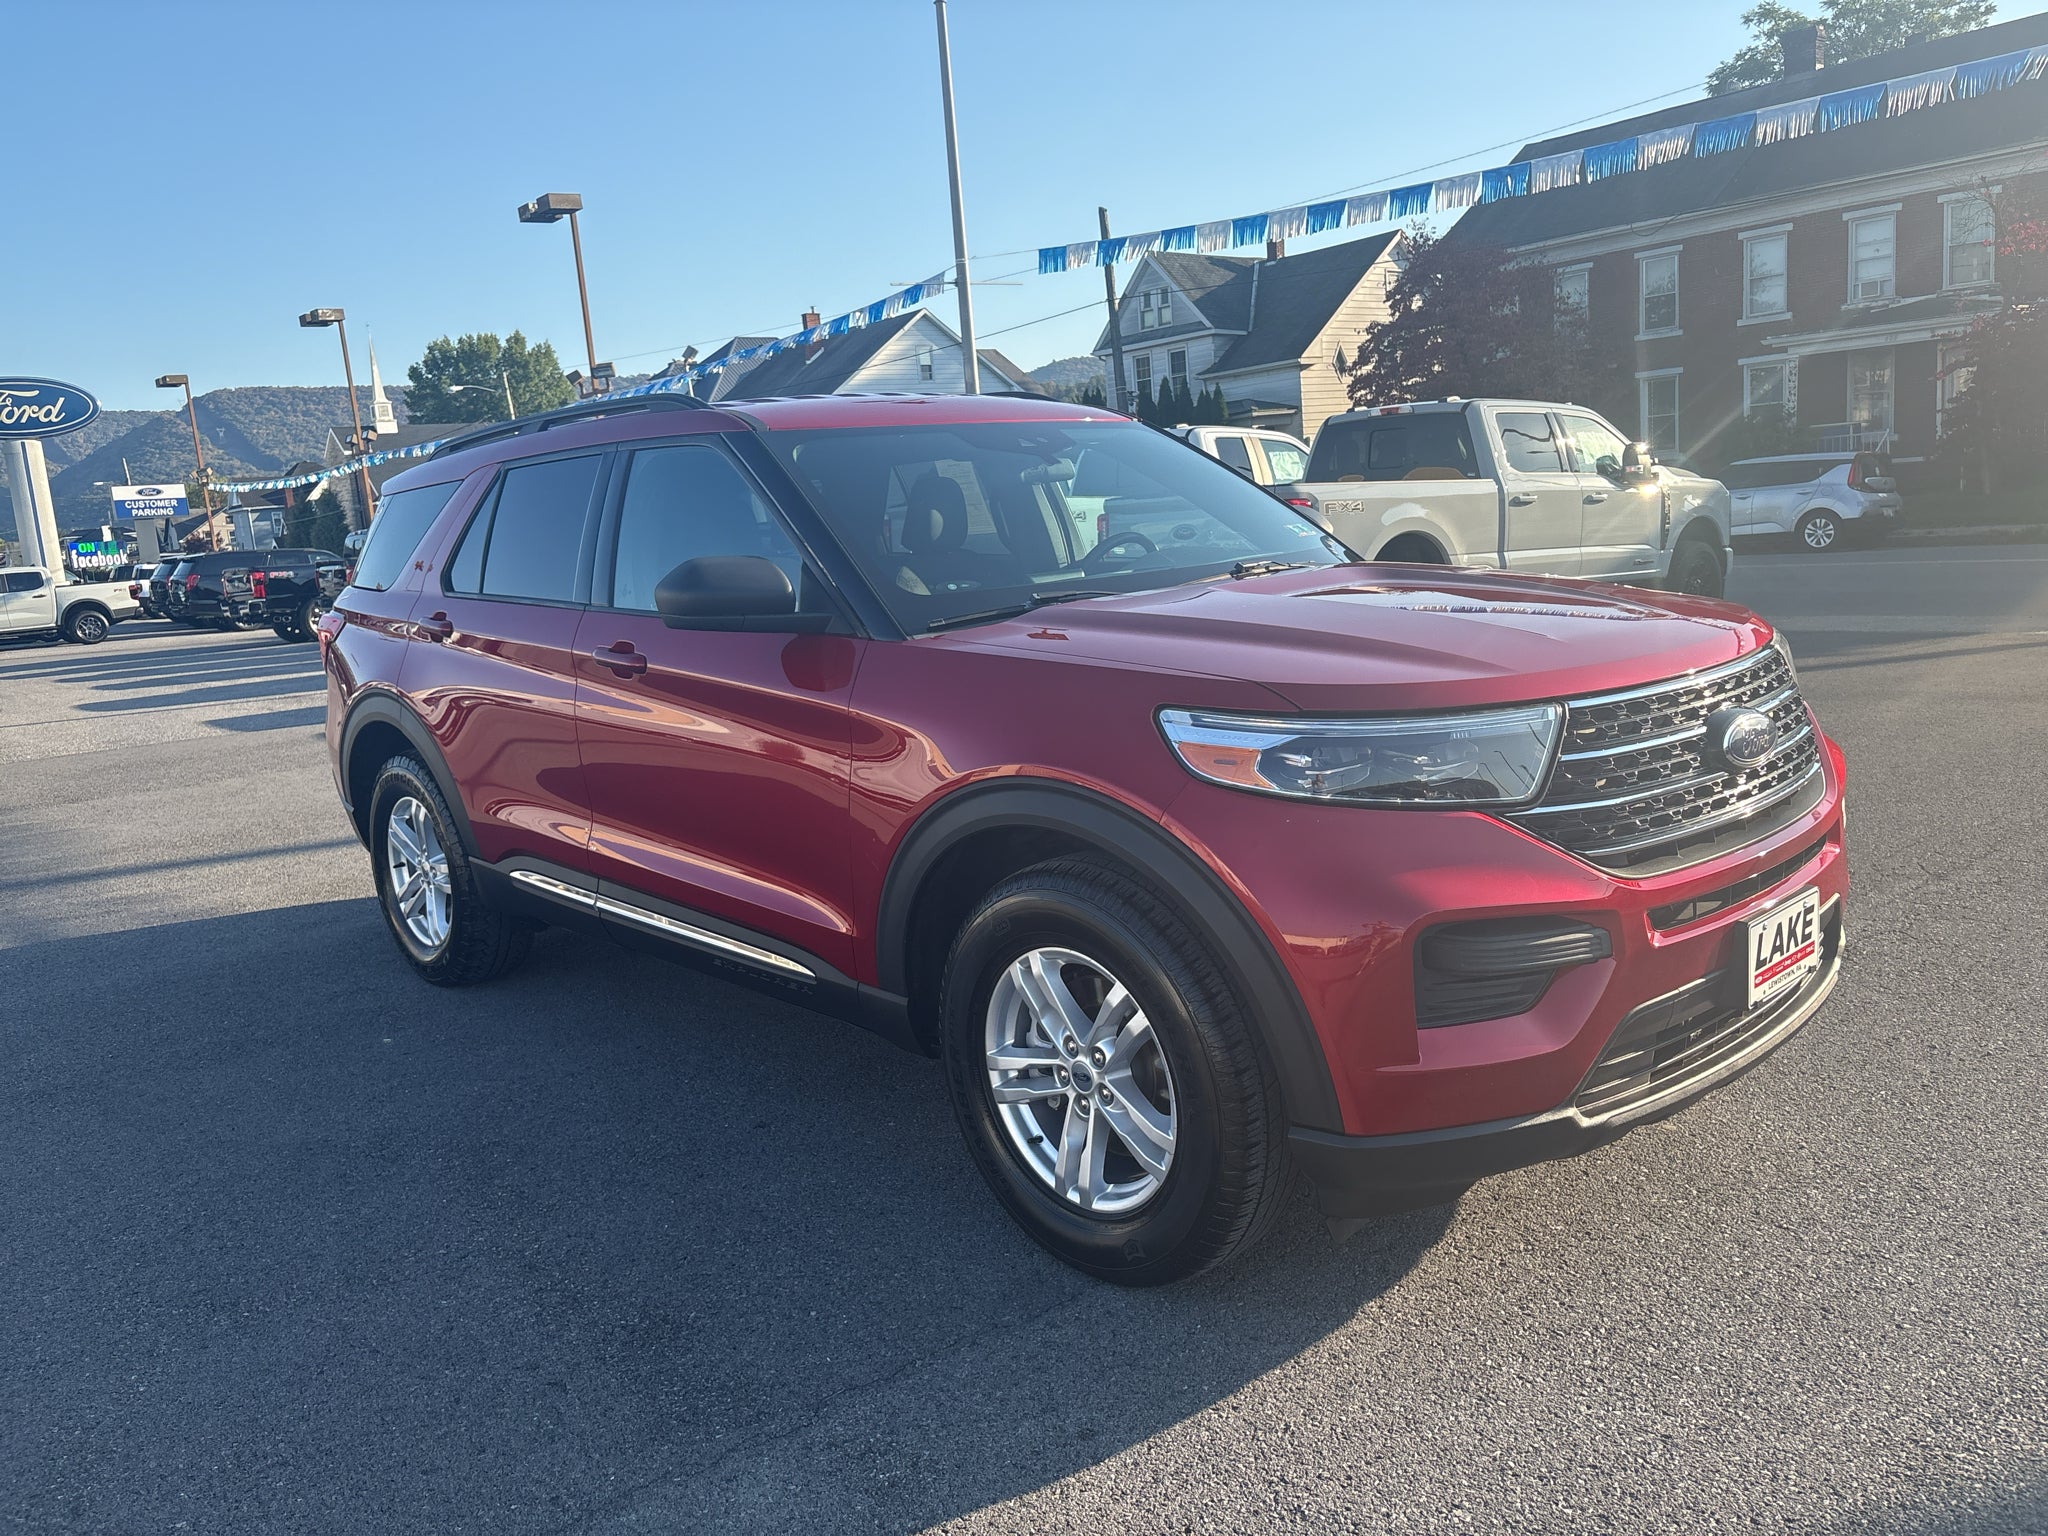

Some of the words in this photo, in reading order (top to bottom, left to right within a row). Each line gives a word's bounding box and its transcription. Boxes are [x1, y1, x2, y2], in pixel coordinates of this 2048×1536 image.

[125, 499, 178, 508] CUSTOMER
[1323, 500, 1365, 515] FX4
[132, 507, 174, 516] PARKING
[77, 542, 95, 553] ON
[71, 549, 128, 568] facebook
[1755, 904, 1815, 972] LAKE
